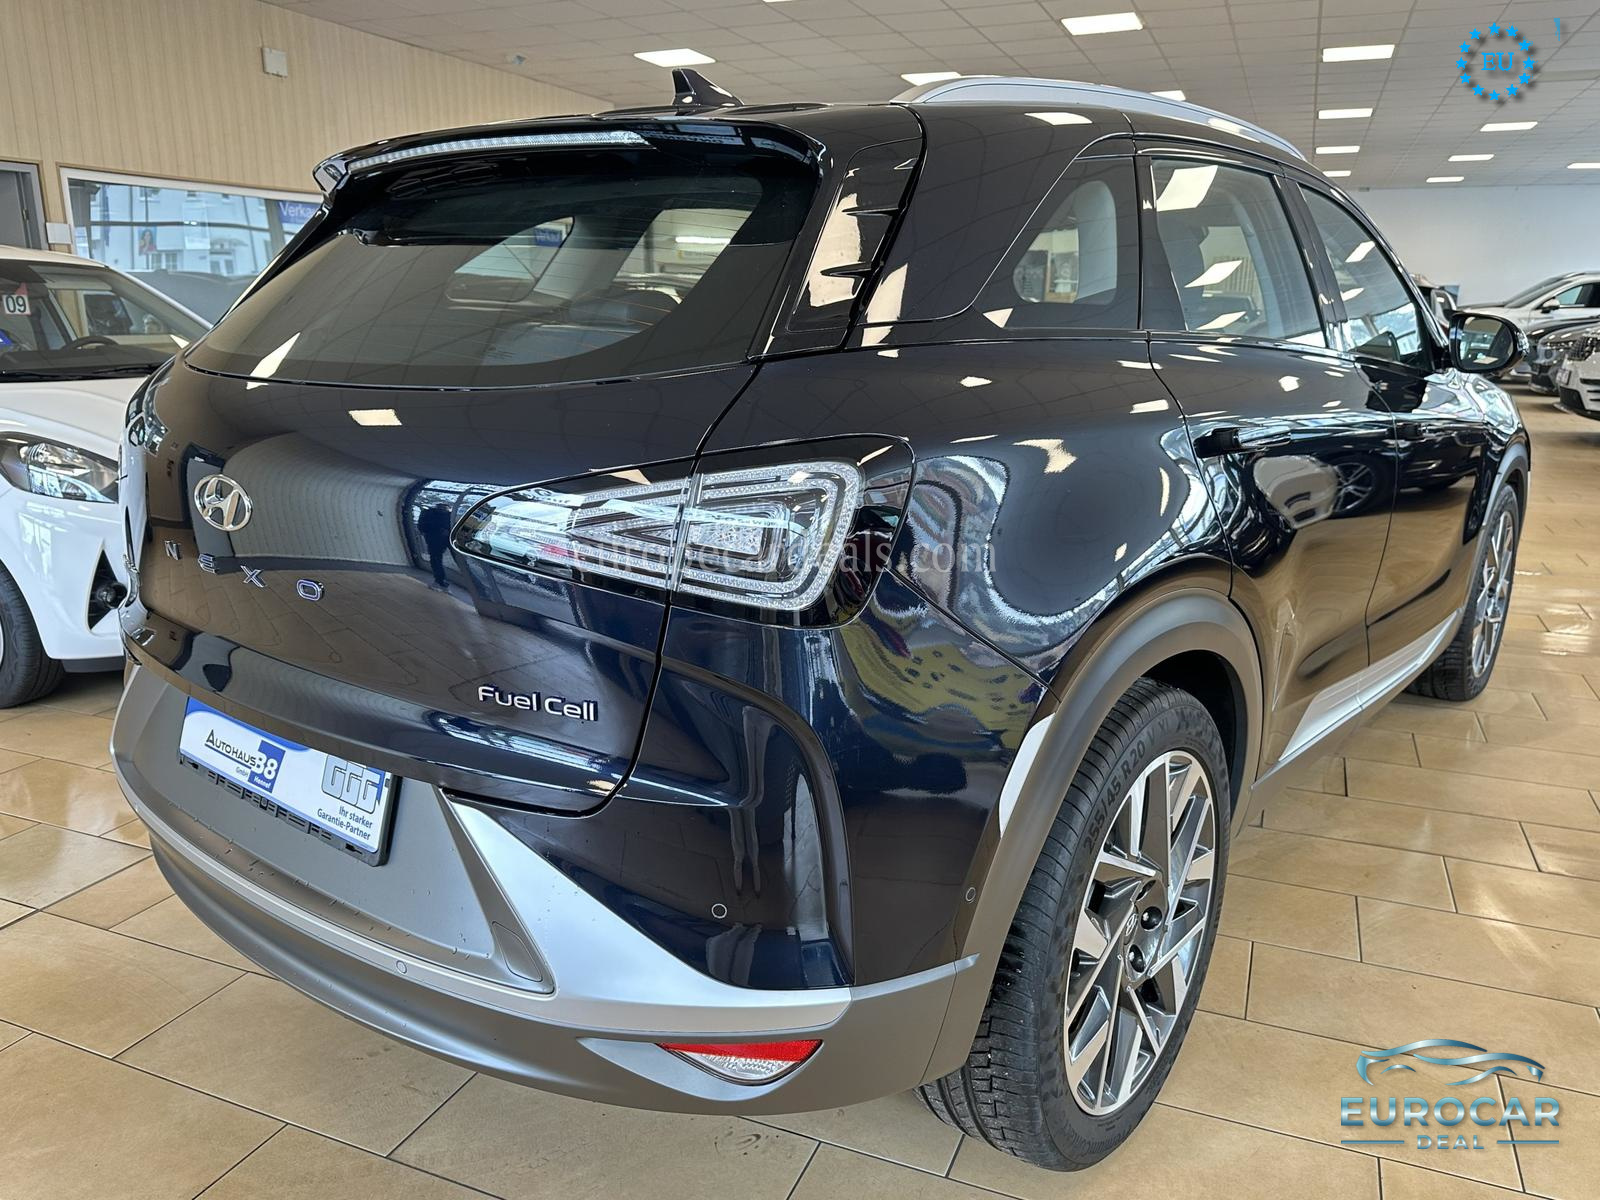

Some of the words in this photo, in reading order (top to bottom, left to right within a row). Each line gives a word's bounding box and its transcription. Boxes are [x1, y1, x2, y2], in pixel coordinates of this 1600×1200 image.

[6, 295, 27, 314] 09
[164, 540, 324, 602] NEXO
[478, 685, 540, 712] Fuel
[544, 696, 597, 721] Cell
[316, 808, 371, 841] Garantie-Partner
[349, 811, 373, 829] starker
[1084, 775, 1121, 855] 255/45
